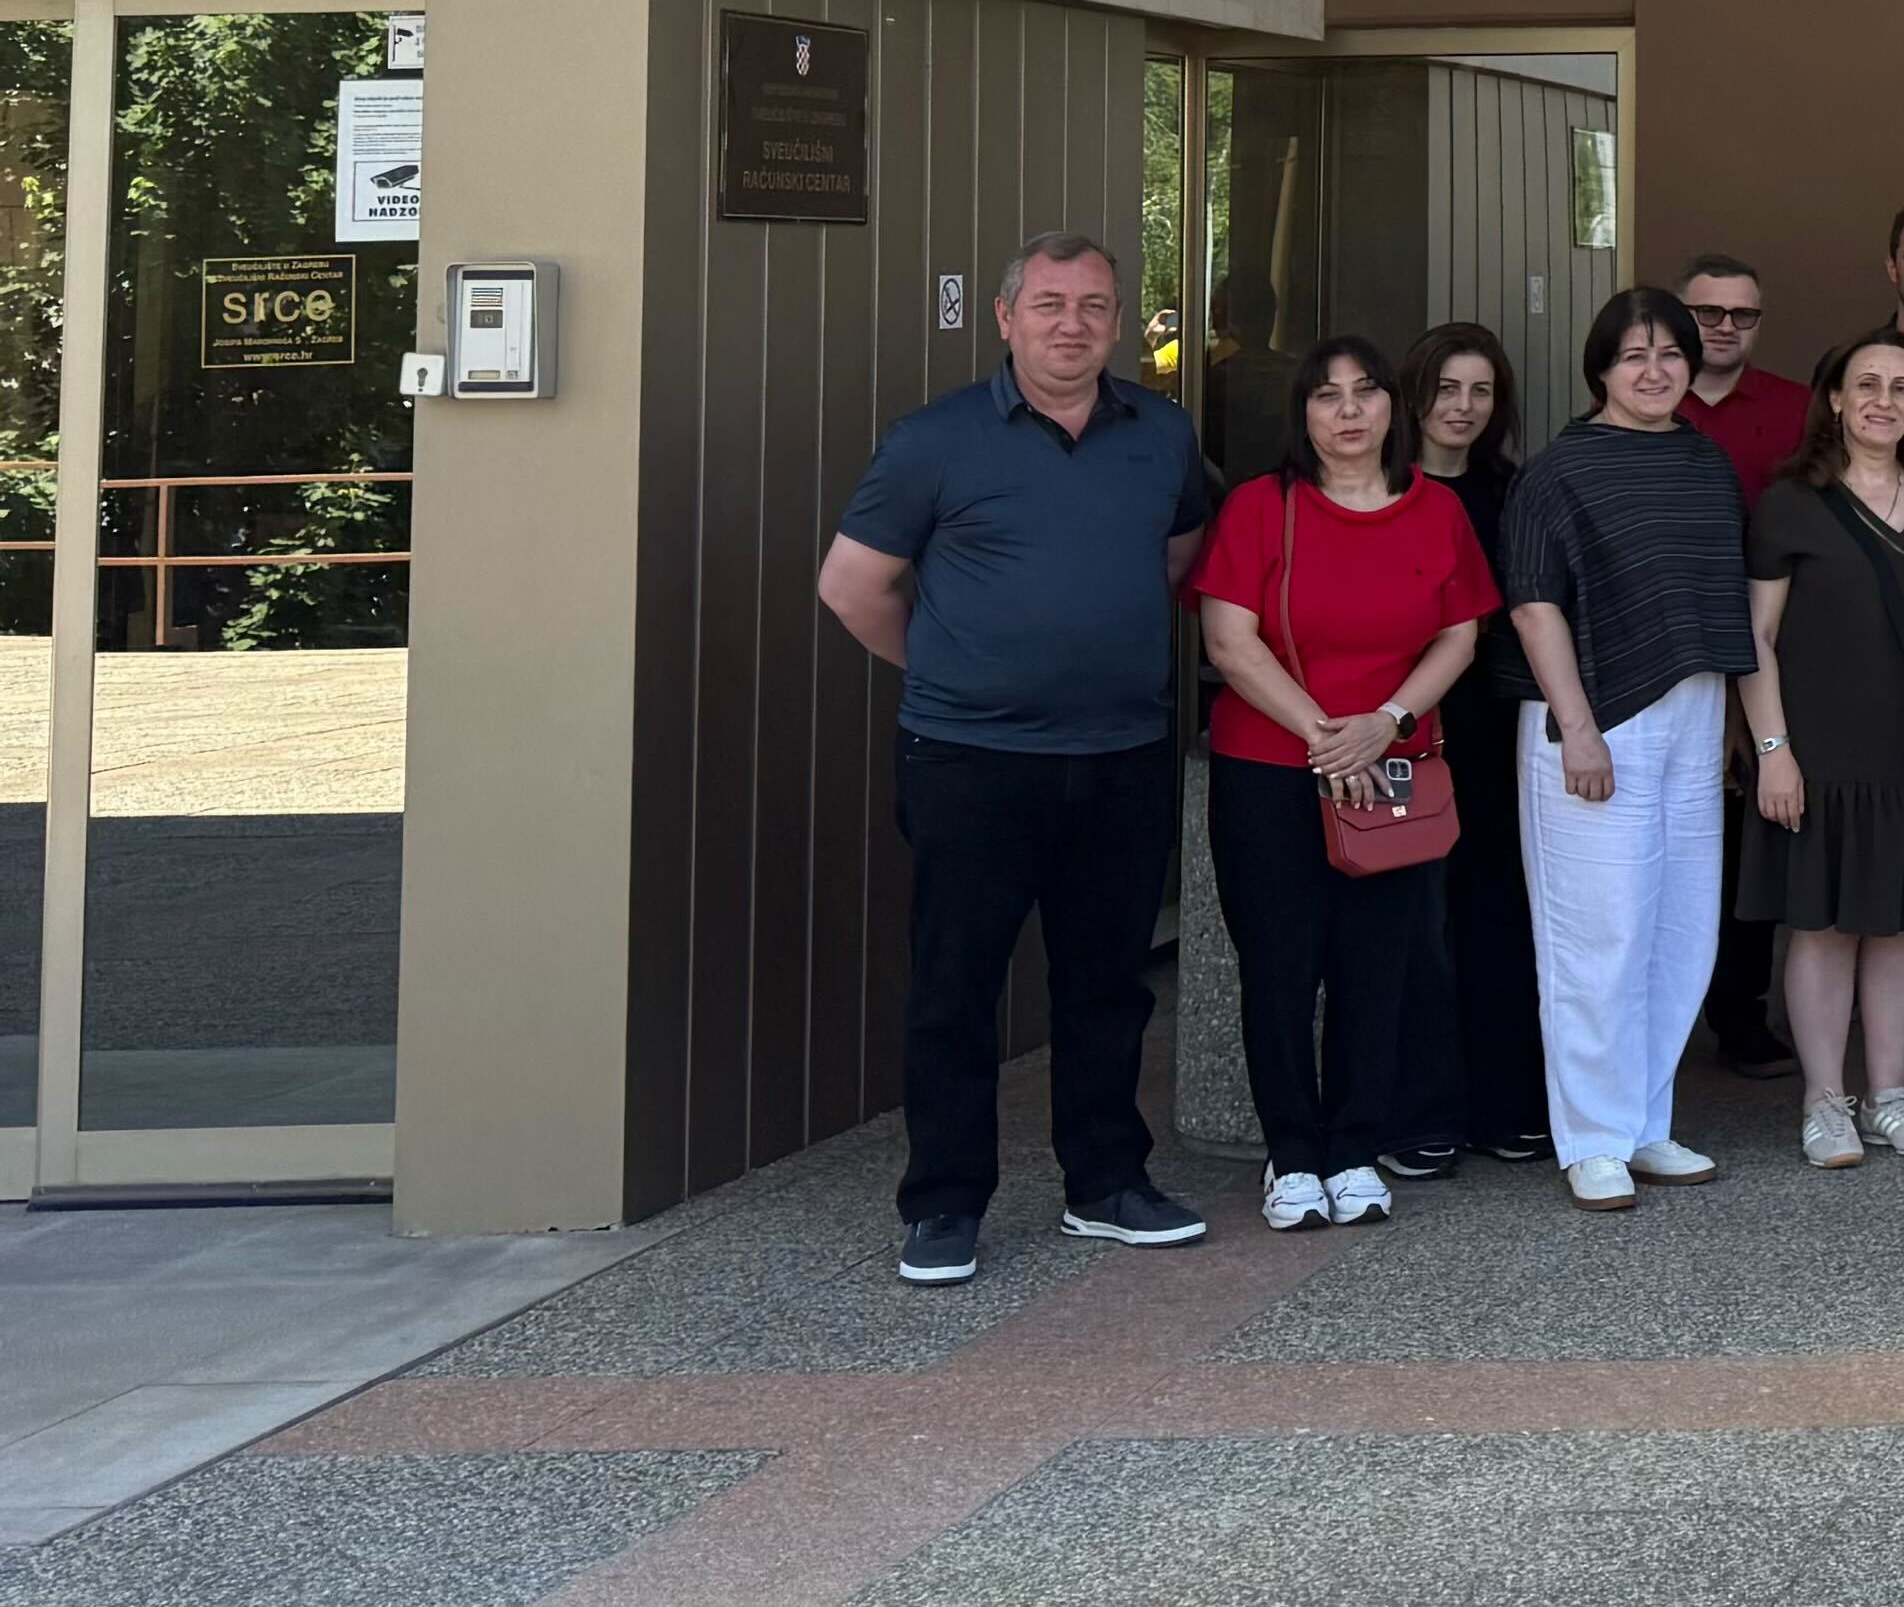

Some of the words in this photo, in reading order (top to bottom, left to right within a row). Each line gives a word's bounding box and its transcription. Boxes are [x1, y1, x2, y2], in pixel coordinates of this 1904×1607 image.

[805, 171, 850, 194] CENTAR
[377, 195, 420, 205] VIDEO
[368, 207, 418, 217] NADZO
[222, 289, 334, 324] srce
